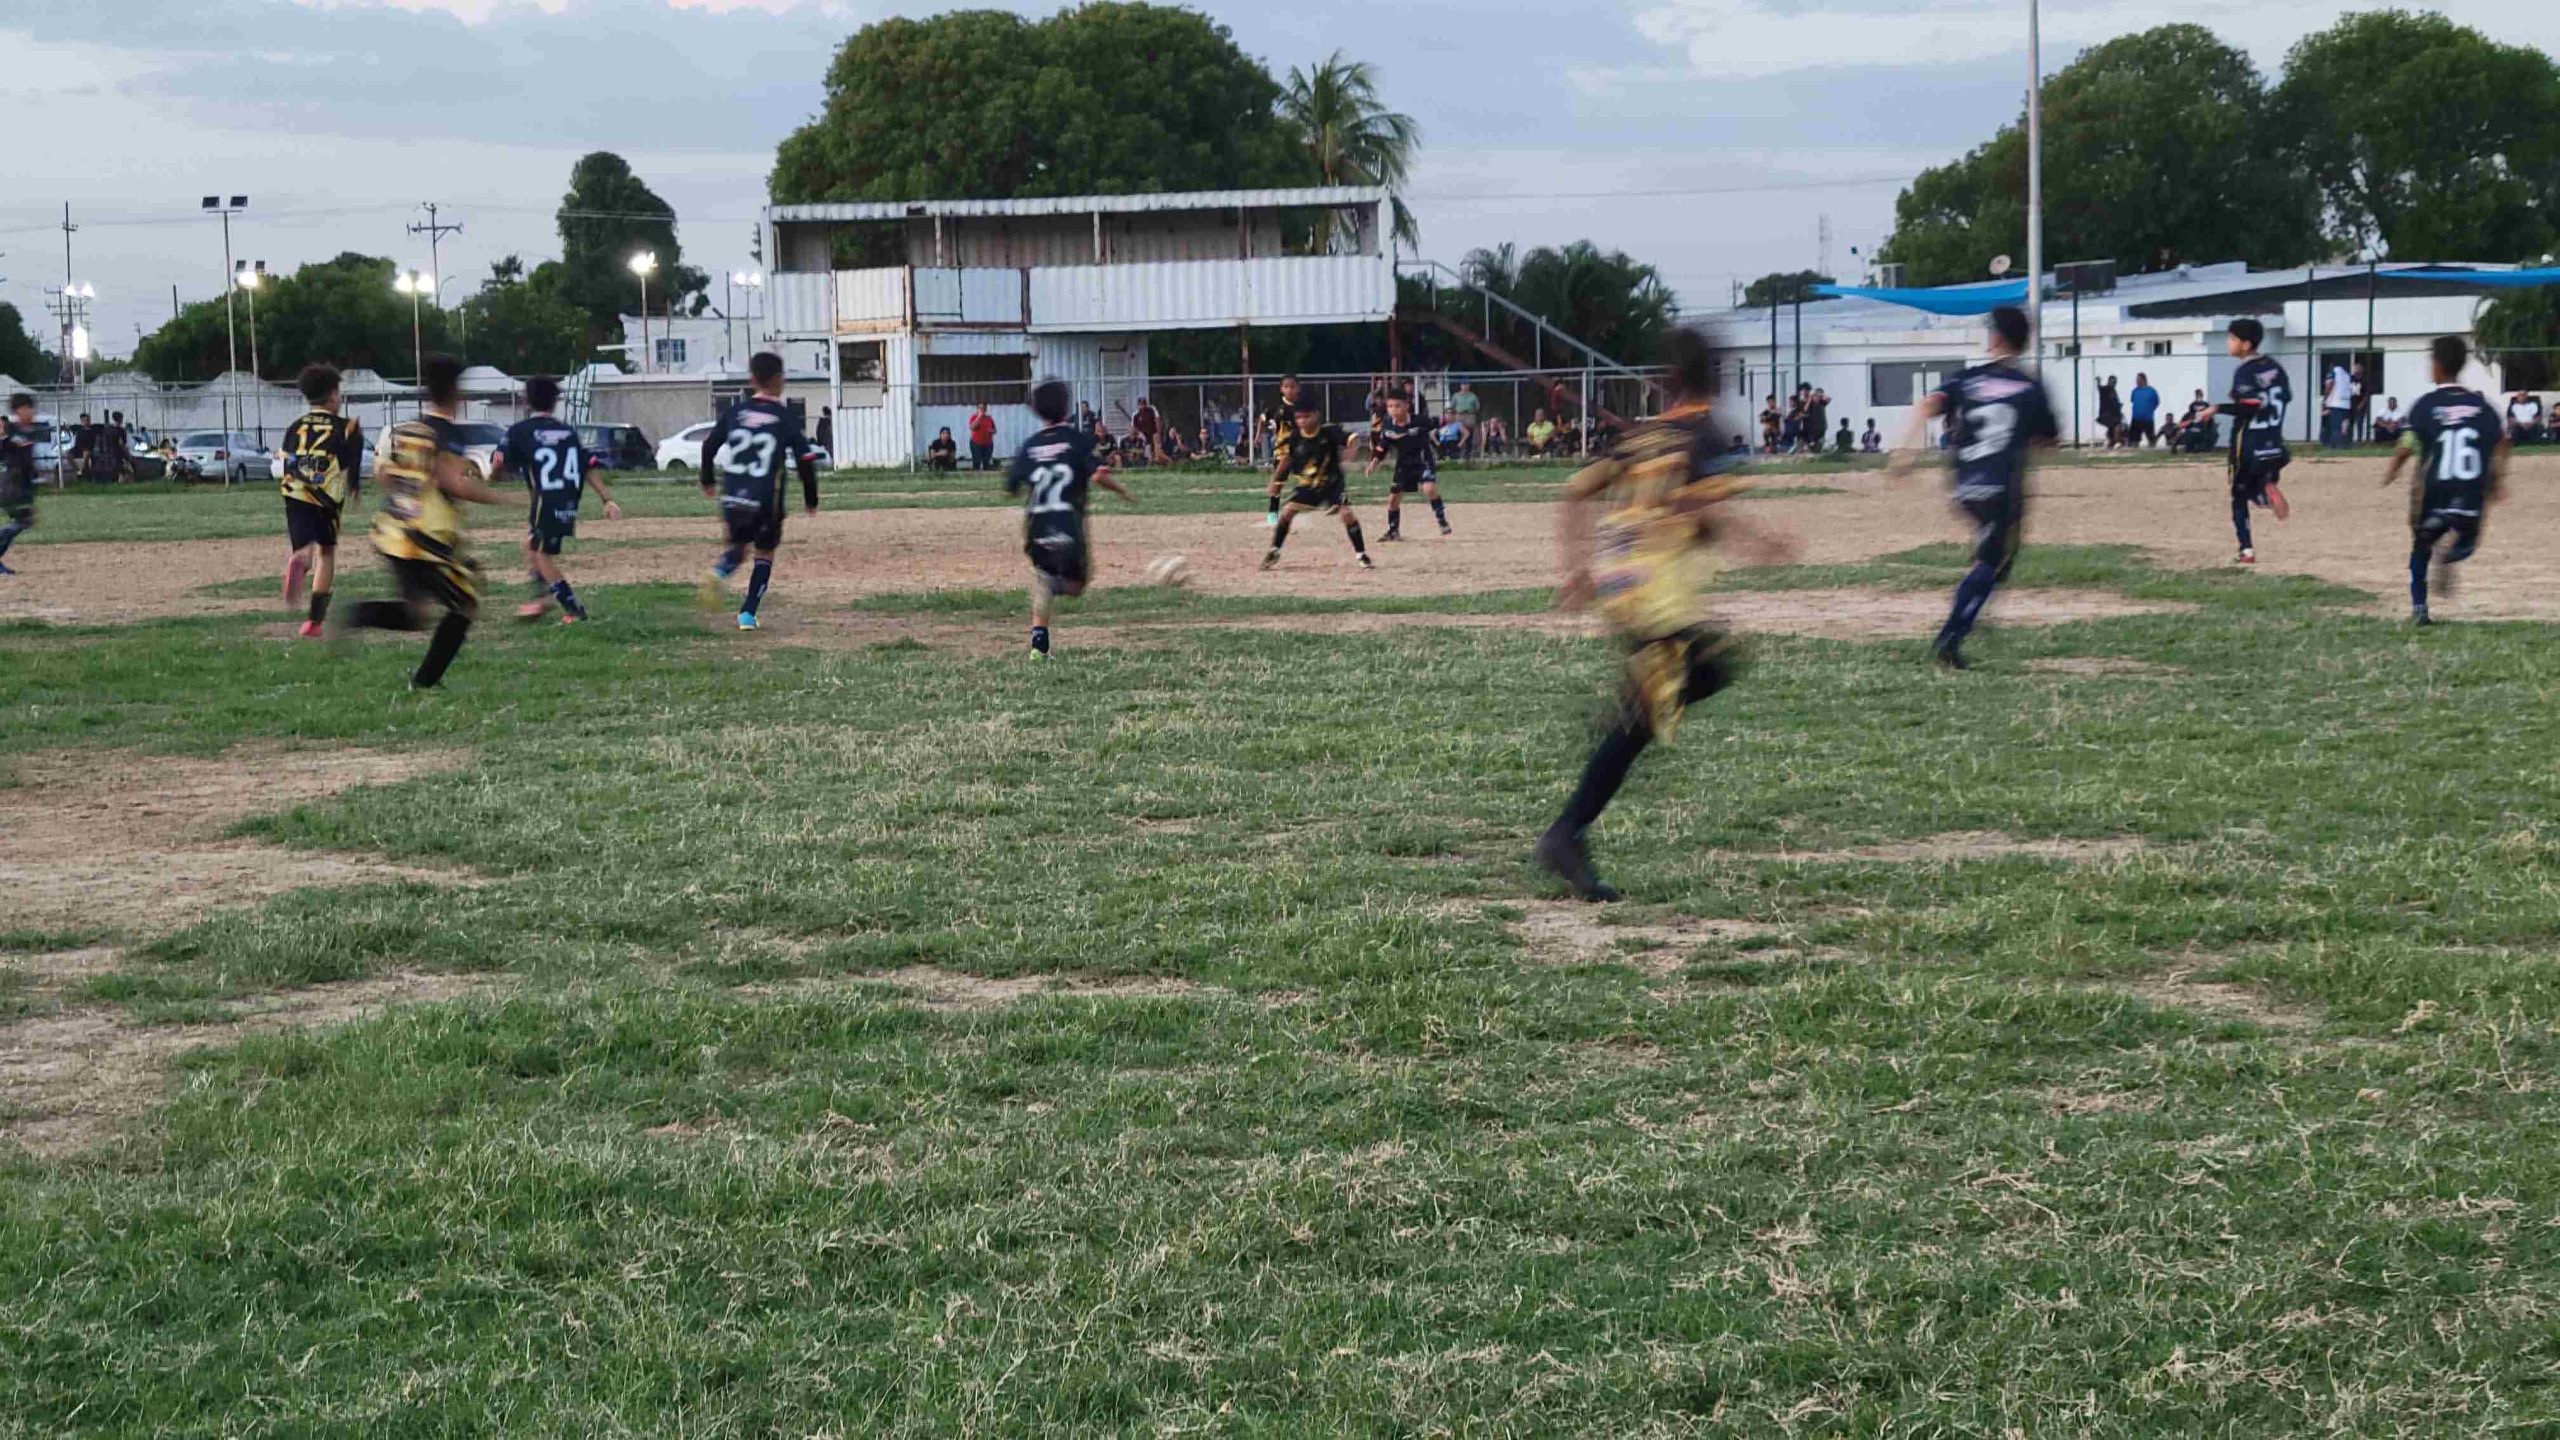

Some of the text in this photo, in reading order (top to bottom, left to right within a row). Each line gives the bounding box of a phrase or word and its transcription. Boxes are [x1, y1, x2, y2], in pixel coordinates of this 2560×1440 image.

[296, 423, 333, 456] 12
[728, 428, 776, 477] 23
[2437, 427, 2481, 480] 16
[534, 447, 579, 490] 24
[1029, 463, 1074, 512] 22
